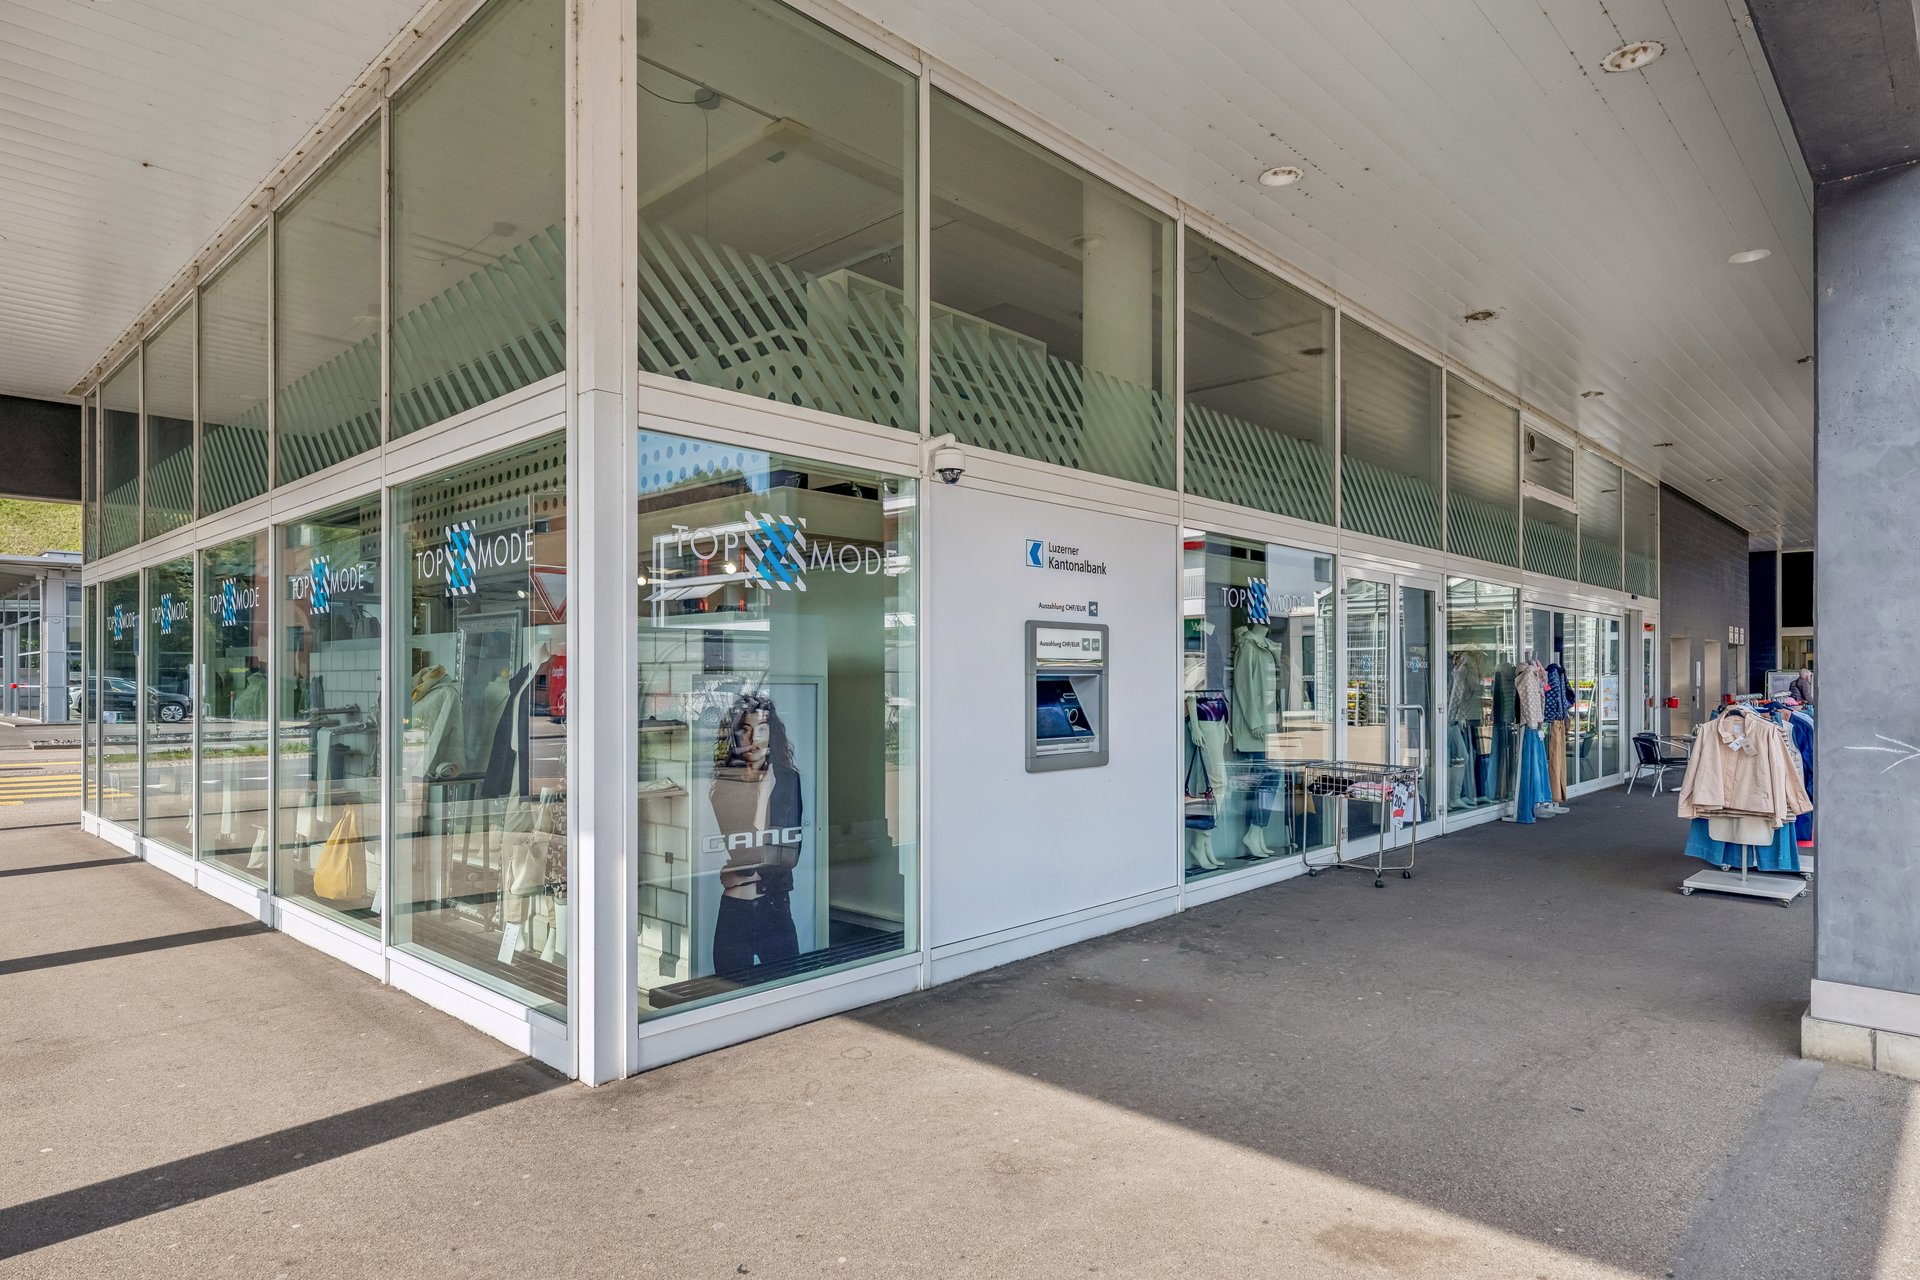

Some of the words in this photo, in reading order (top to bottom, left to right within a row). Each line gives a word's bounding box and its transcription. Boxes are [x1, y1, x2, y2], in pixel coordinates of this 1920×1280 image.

[416, 549, 444, 580] TOP
[478, 529, 534, 570] MODE
[671, 524, 739, 561] TOP
[810, 540, 897, 577] MODE
[1048, 542, 1079, 556] Luzerner
[1048, 556, 1107, 575] Kantonalbank
[292, 576, 310, 600] TOP
[330, 564, 365, 594] MODE
[152, 606, 161, 623] TOP
[171, 601, 188, 621] MODE
[209, 595, 223, 614] TOP
[236, 587, 260, 610] MODE
[1038, 602, 1064, 612] Auszahlung
[1065, 604, 1086, 612] CHF/EUR
[1221, 587, 1247, 608] TOP
[1270, 592, 1306, 613] MODE
[106, 616, 114, 630] TOP
[122, 612, 135, 629] MODE
[702, 827, 802, 853] GANG
